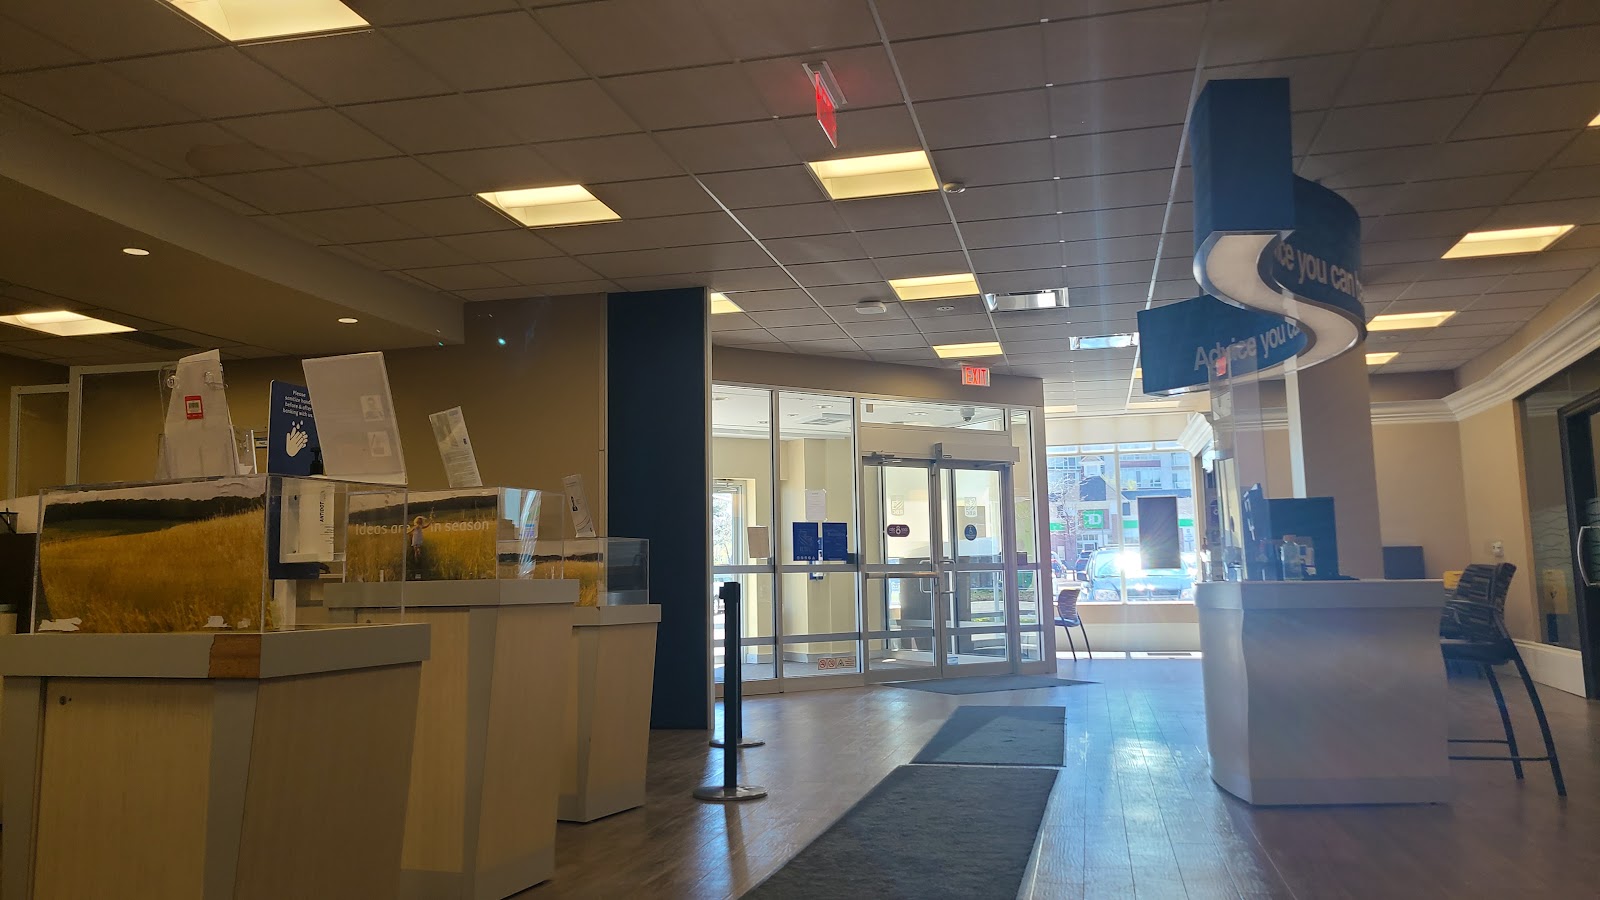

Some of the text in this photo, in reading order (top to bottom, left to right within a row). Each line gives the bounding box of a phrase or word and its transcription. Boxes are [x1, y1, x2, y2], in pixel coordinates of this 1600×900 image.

[1297, 249, 1328, 285] you
[1330, 264, 1355, 297] can
[1193, 337, 1256, 371] Advice
[1259, 324, 1286, 359] you
[966, 367, 987, 385] EXIT
[282, 408, 299, 416] banking
[390, 524, 411, 535] are
[430, 521, 441, 533] in
[445, 520, 490, 532] season
